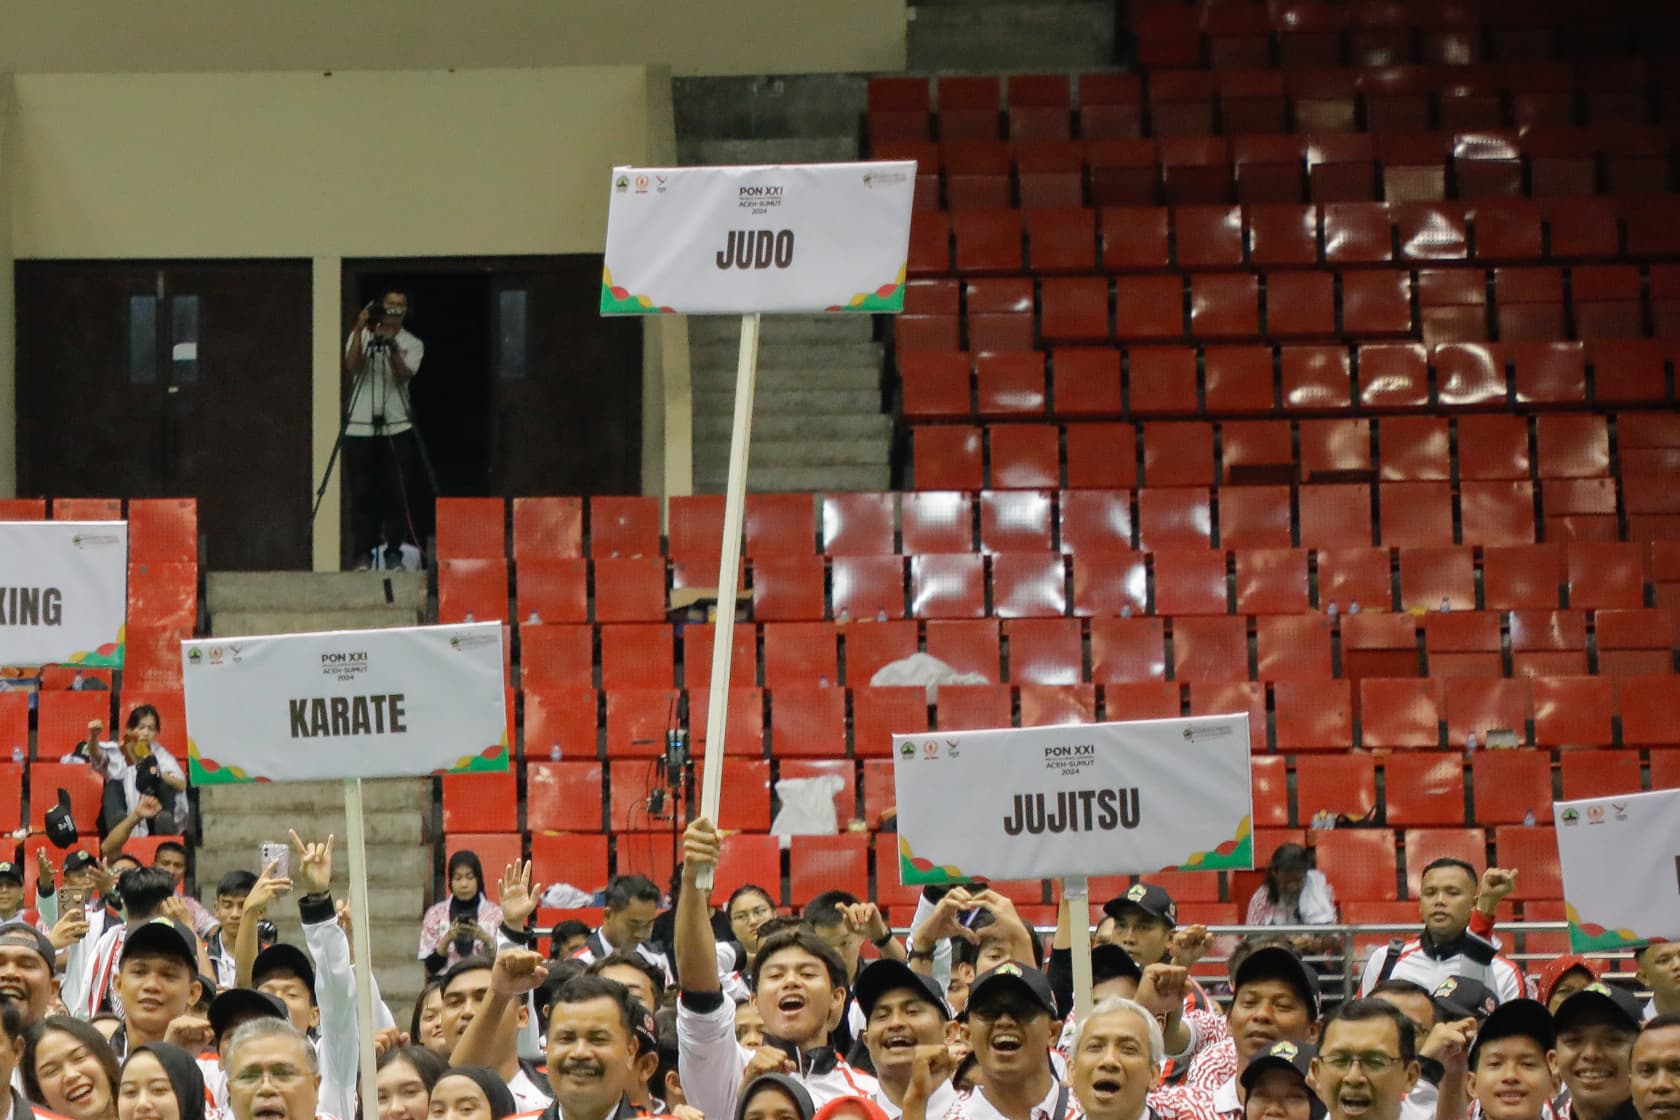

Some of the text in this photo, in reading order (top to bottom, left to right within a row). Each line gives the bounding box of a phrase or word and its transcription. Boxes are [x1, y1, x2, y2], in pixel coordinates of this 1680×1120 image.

[739, 187, 763, 196] PON
[716, 229, 795, 270] JUDO
[322, 651, 368, 663] PON XXI
[289, 693, 408, 738] KARATE
[1045, 745, 1095, 757] PON XXI
[1003, 787, 1141, 836] JUJITSU
